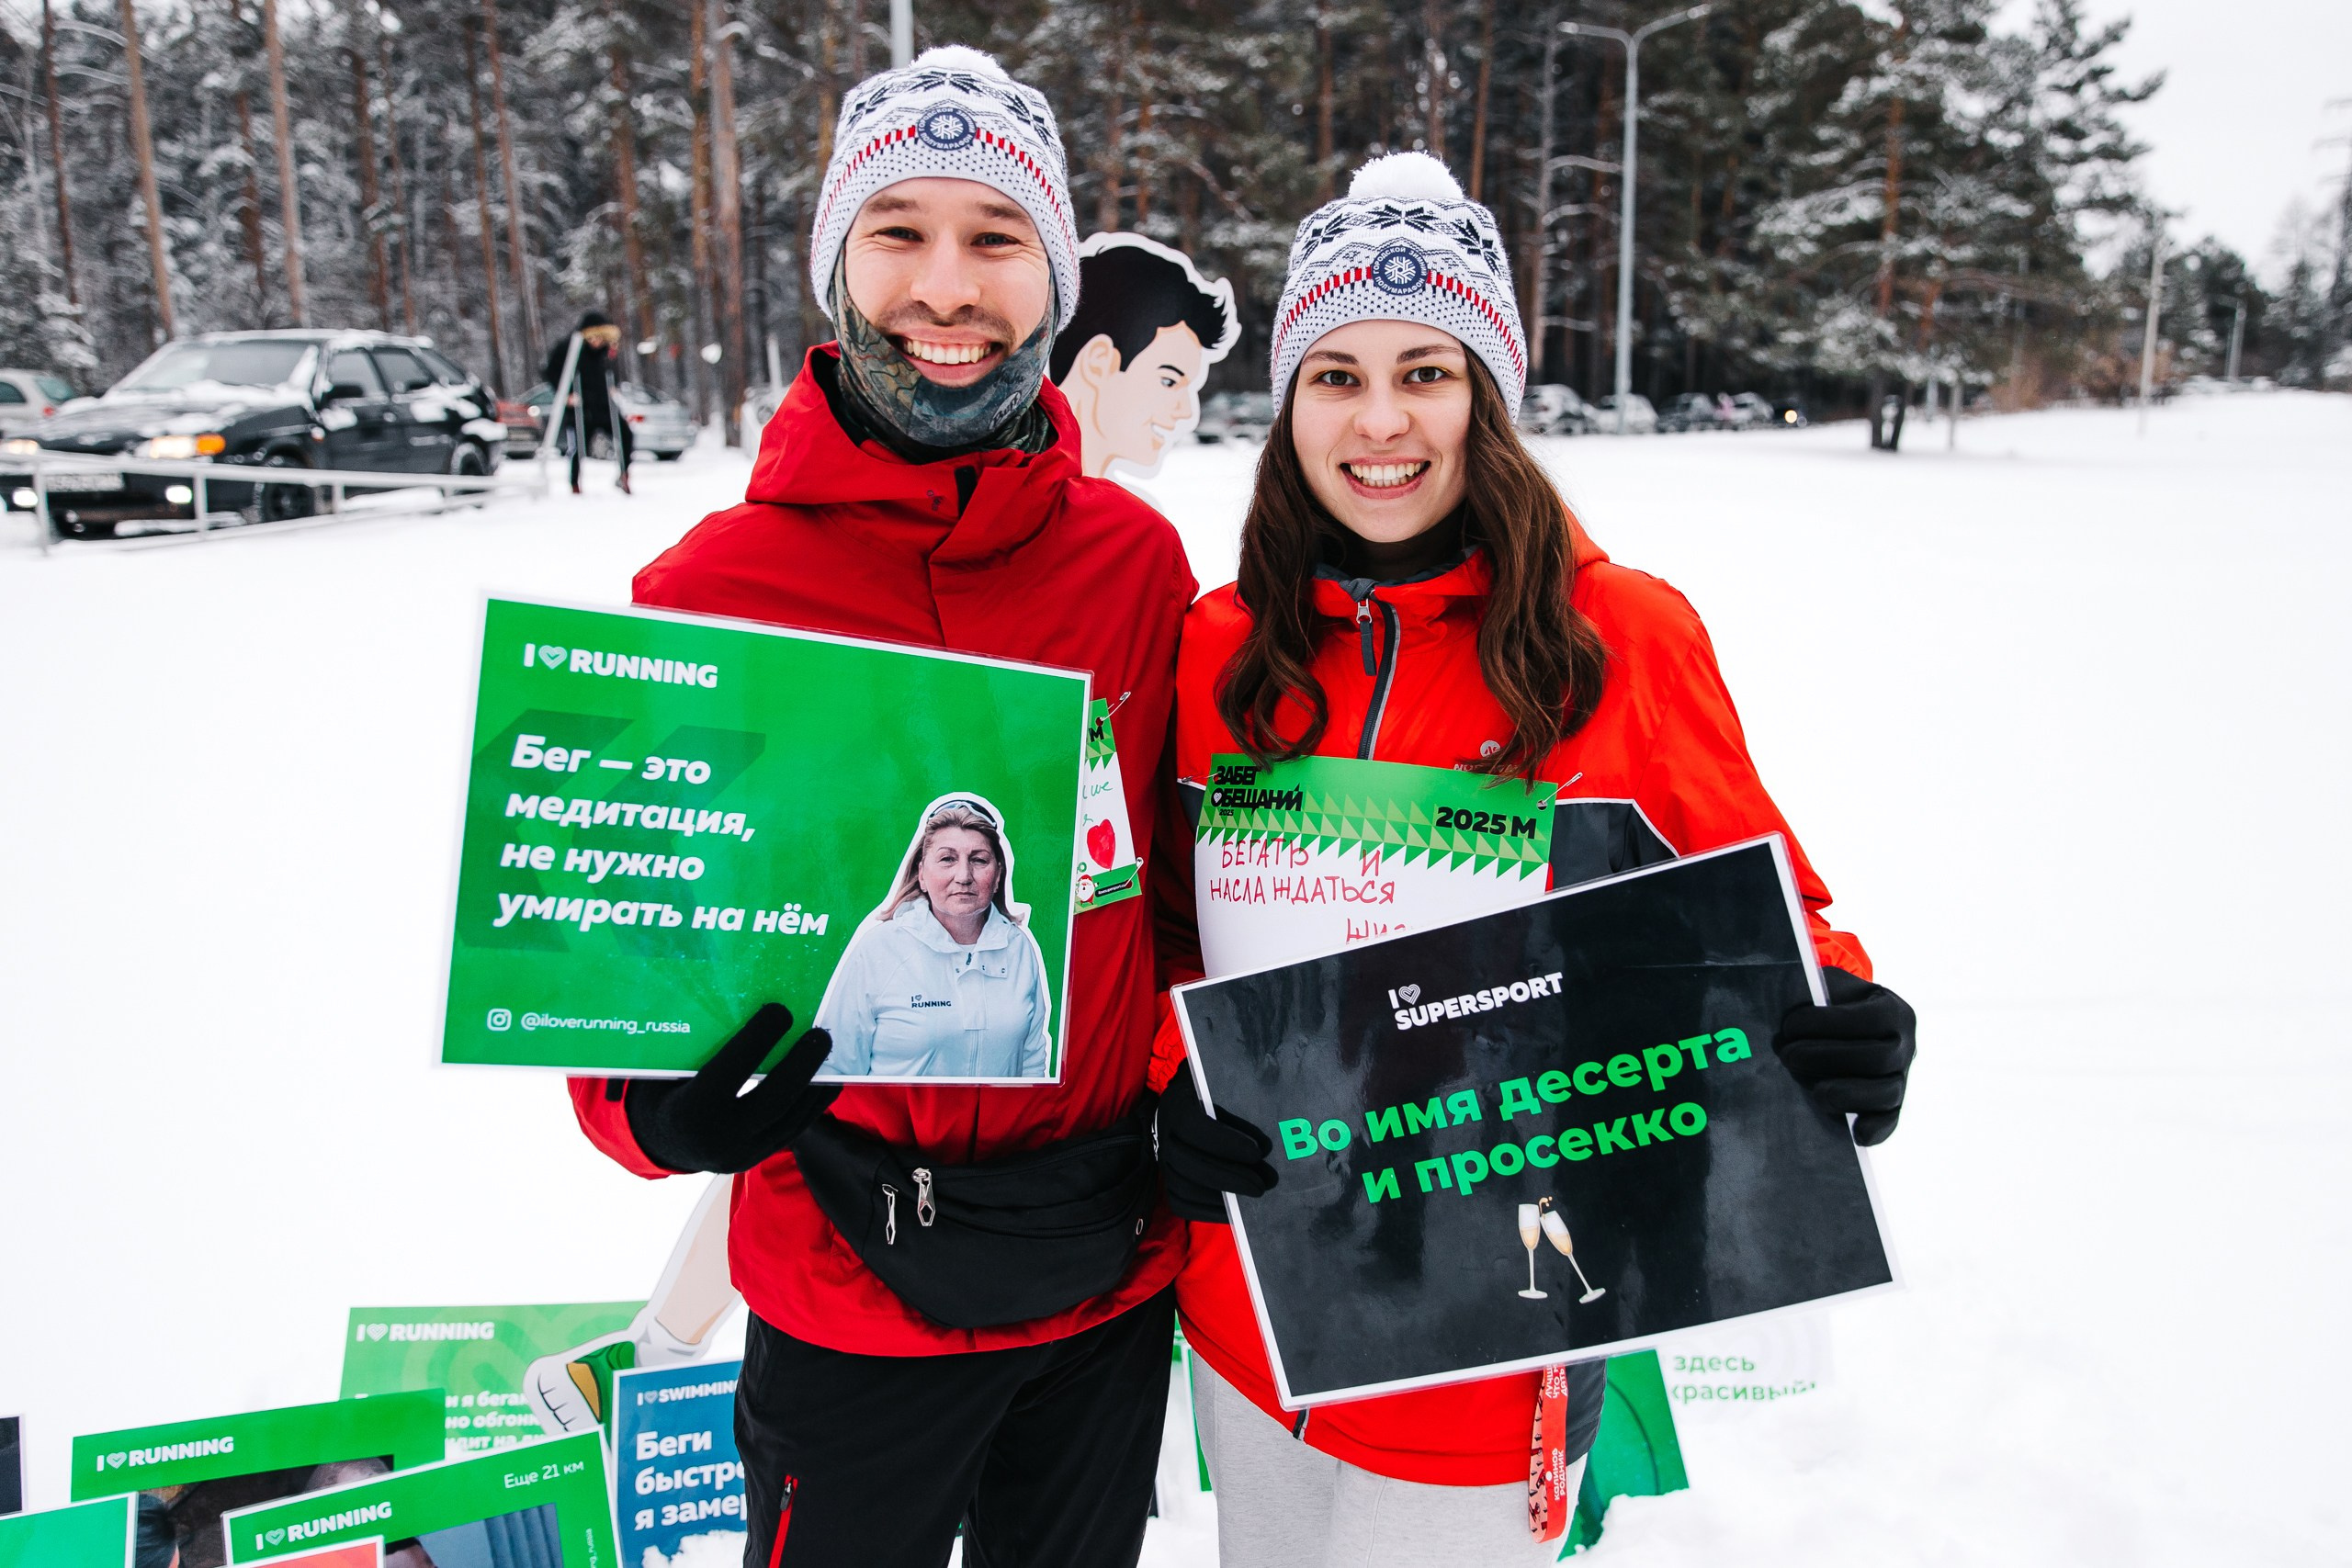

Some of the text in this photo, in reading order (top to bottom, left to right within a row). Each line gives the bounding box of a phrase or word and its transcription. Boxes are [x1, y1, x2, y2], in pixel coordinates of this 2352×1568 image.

[1373, 247, 1406, 274] ГОРОДСКОЙ
[1374, 276, 1425, 294] ПОЛУМАРАФОН
[524, 643, 718, 688] I RUNNING
[511, 734, 592, 773] Бег
[641, 756, 711, 784] это
[1213, 765, 1262, 785] ЗАБЕГ
[1211, 783, 1304, 816] ОБЕЩАНИЙ
[505, 793, 755, 841] медитация,
[1436, 807, 1507, 835] 2025
[500, 843, 705, 884] не нужно
[1222, 838, 1381, 876] БЕГАТЬ И
[492, 893, 829, 935] умирать на нём
[1388, 989, 1399, 1009] I
[1395, 972, 1563, 1031] SUPERSPORT
[521, 1012, 691, 1035] @iloverunning_russia
[1279, 1027, 1753, 1160] Во имя десерта
[1362, 1101, 1707, 1203] и просекко
[356, 1322, 494, 1341] I RUNNING
[1675, 1357, 1755, 1373] здесь
[637, 1380, 738, 1406] I SWIMMIN
[1545, 1367, 1554, 1398] ЛУЧШ
[96, 1436, 234, 1472] I RUNNING
[636, 1430, 712, 1461] Беги
[503, 1461, 584, 1489] Еще 21 км
[255, 1501, 392, 1551] I RUNNING
[634, 1508, 654, 1531] я
